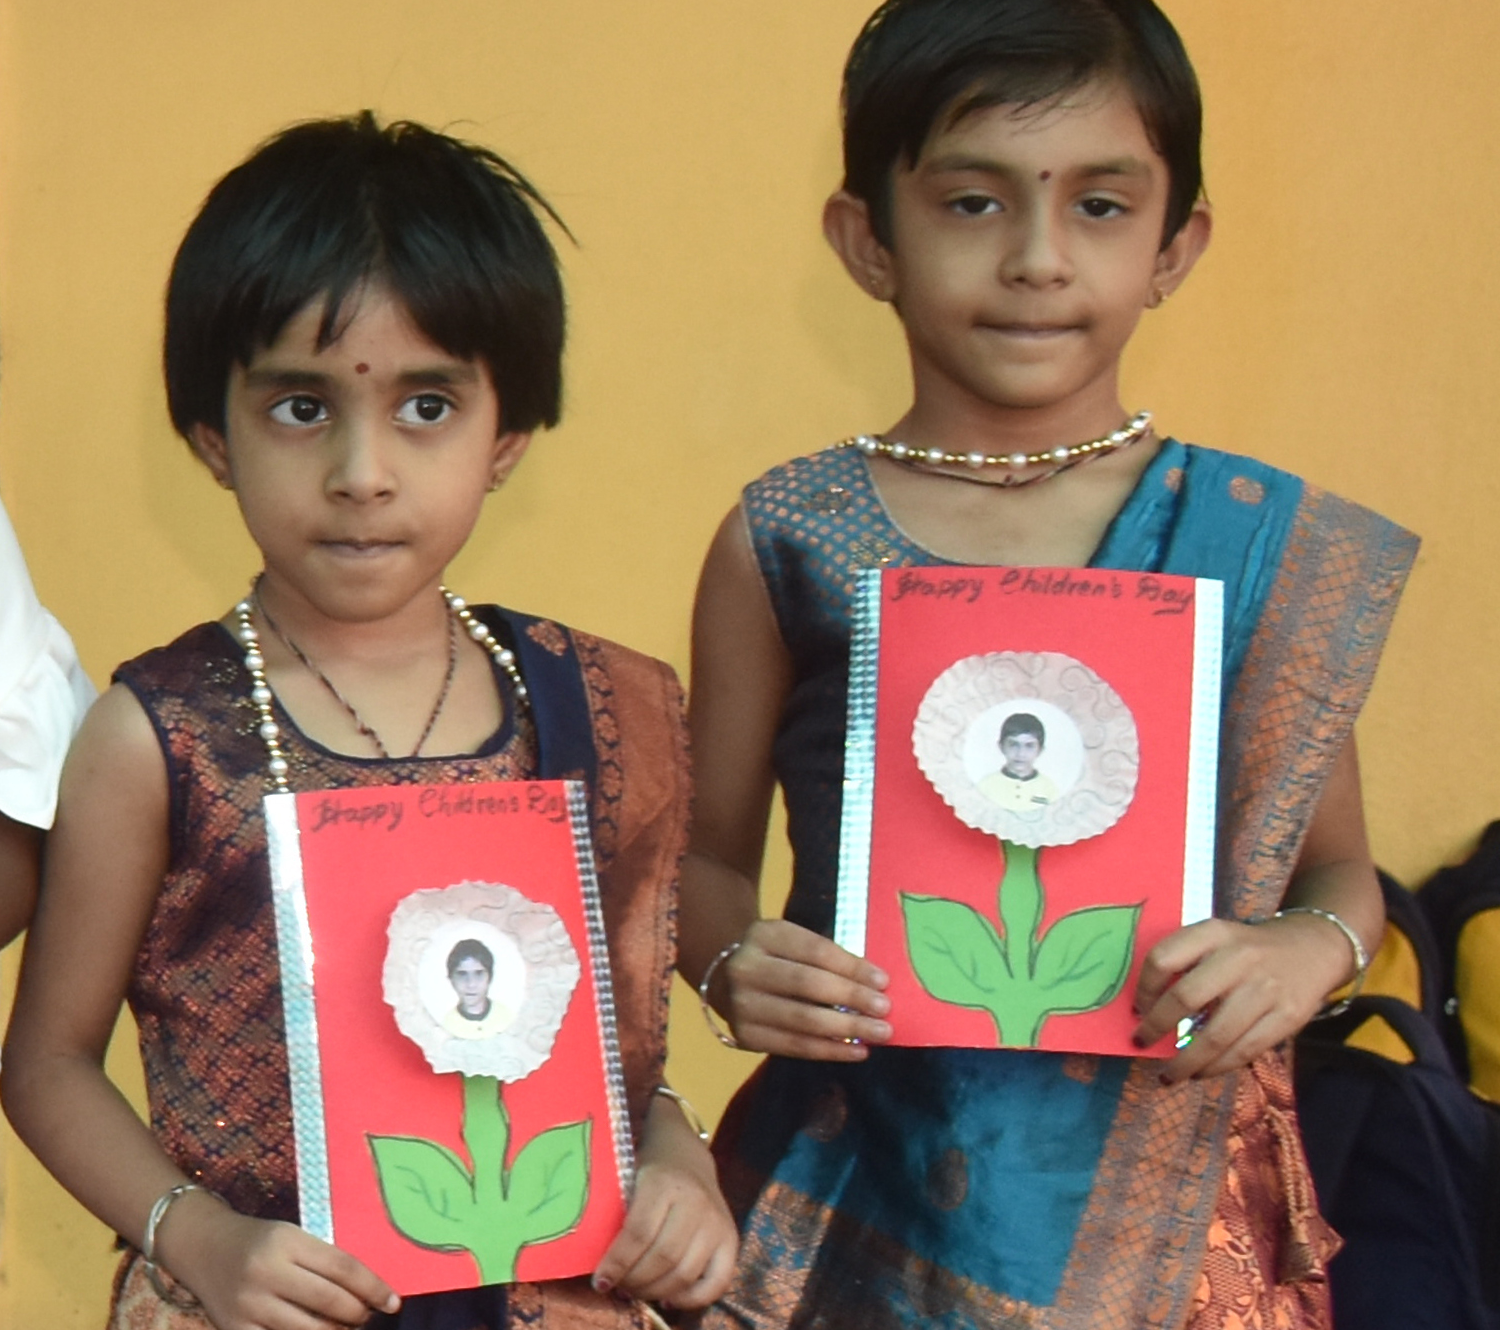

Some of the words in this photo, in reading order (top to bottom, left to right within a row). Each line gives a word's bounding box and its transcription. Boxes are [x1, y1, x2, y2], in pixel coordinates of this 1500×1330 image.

[892, 571, 984, 603] Happy
[999, 570, 1122, 599] Children's
[1135, 575, 1195, 616] Day
[311, 798, 404, 832] Happy
